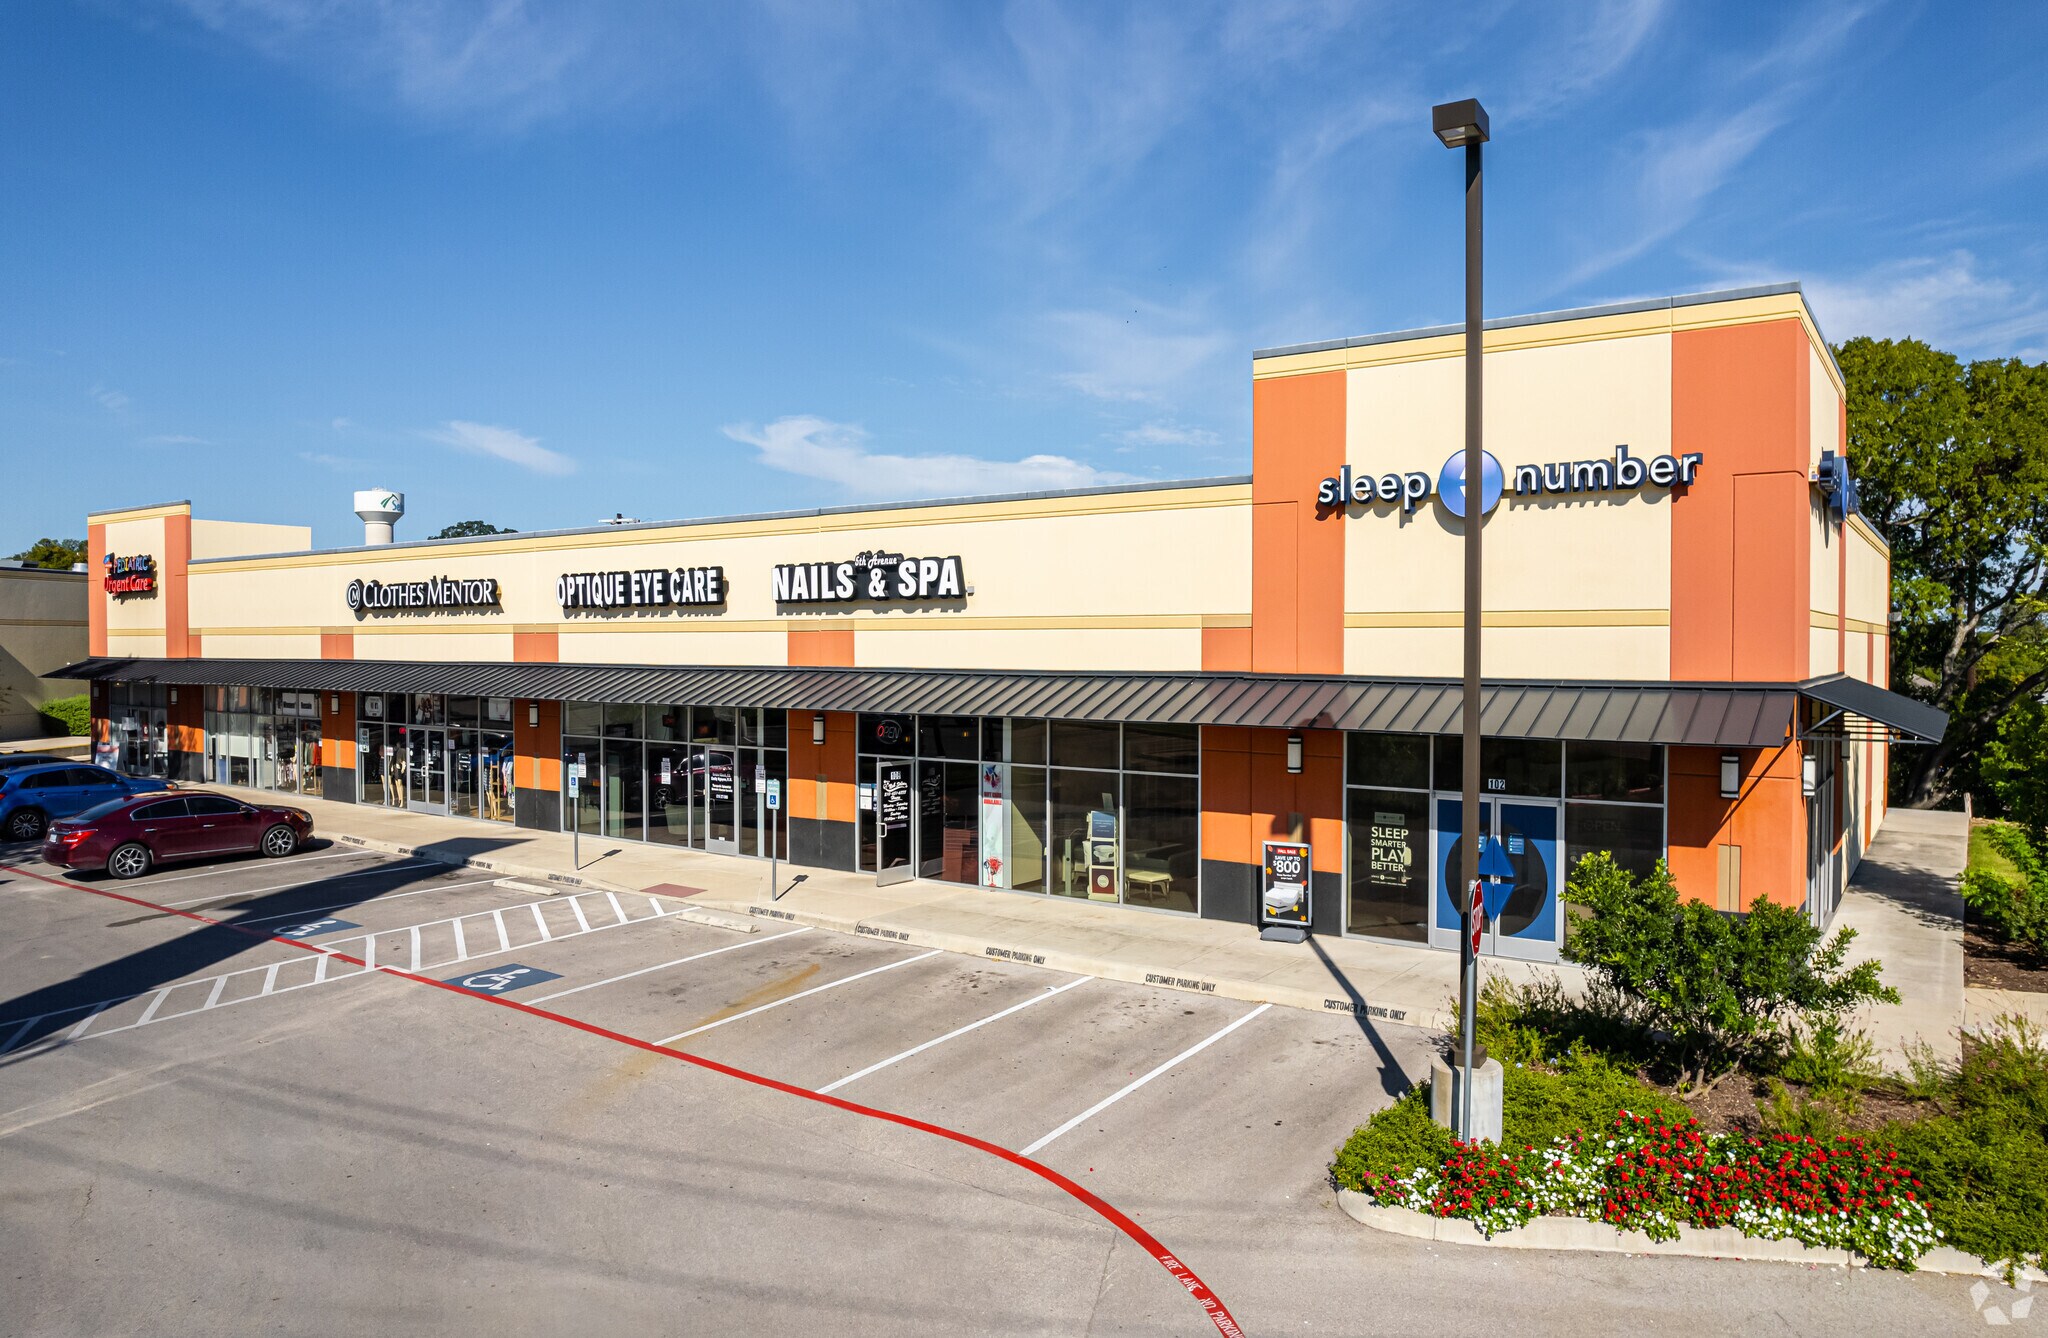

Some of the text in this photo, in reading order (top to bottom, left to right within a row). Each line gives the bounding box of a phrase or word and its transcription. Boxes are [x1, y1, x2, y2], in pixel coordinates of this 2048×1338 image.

[1318, 447, 1699, 511] sleep number
[854, 553, 898, 569] 5th Avenue
[104, 574, 150, 596] Urgent Care
[771, 558, 961, 601] NAILS & SPA
[555, 569, 719, 608] OPTIQUE EYE CARE
[1488, 779, 1506, 790] 102
[1371, 826, 1409, 839] SLEEP
[1371, 839, 1407, 849] SMARTER
[1371, 847, 1405, 863] PLAY
[1273, 860, 1301, 874] $800
[749, 906, 795, 921] CUSTOMER PARKING ONLY
[857, 925, 910, 941] CUSTOMER PARKING ONLY
[985, 946, 1046, 965] CUSTOMER PARKING ONLY
[1145, 973, 1216, 992] CUSTOMER PARKING ONLY
[1323, 999, 1407, 1021] CUSTOMER PARKING ONLY
[1199, 1297, 1217, 1309] NO
[1209, 1310, 1245, 1338] PARKIN
